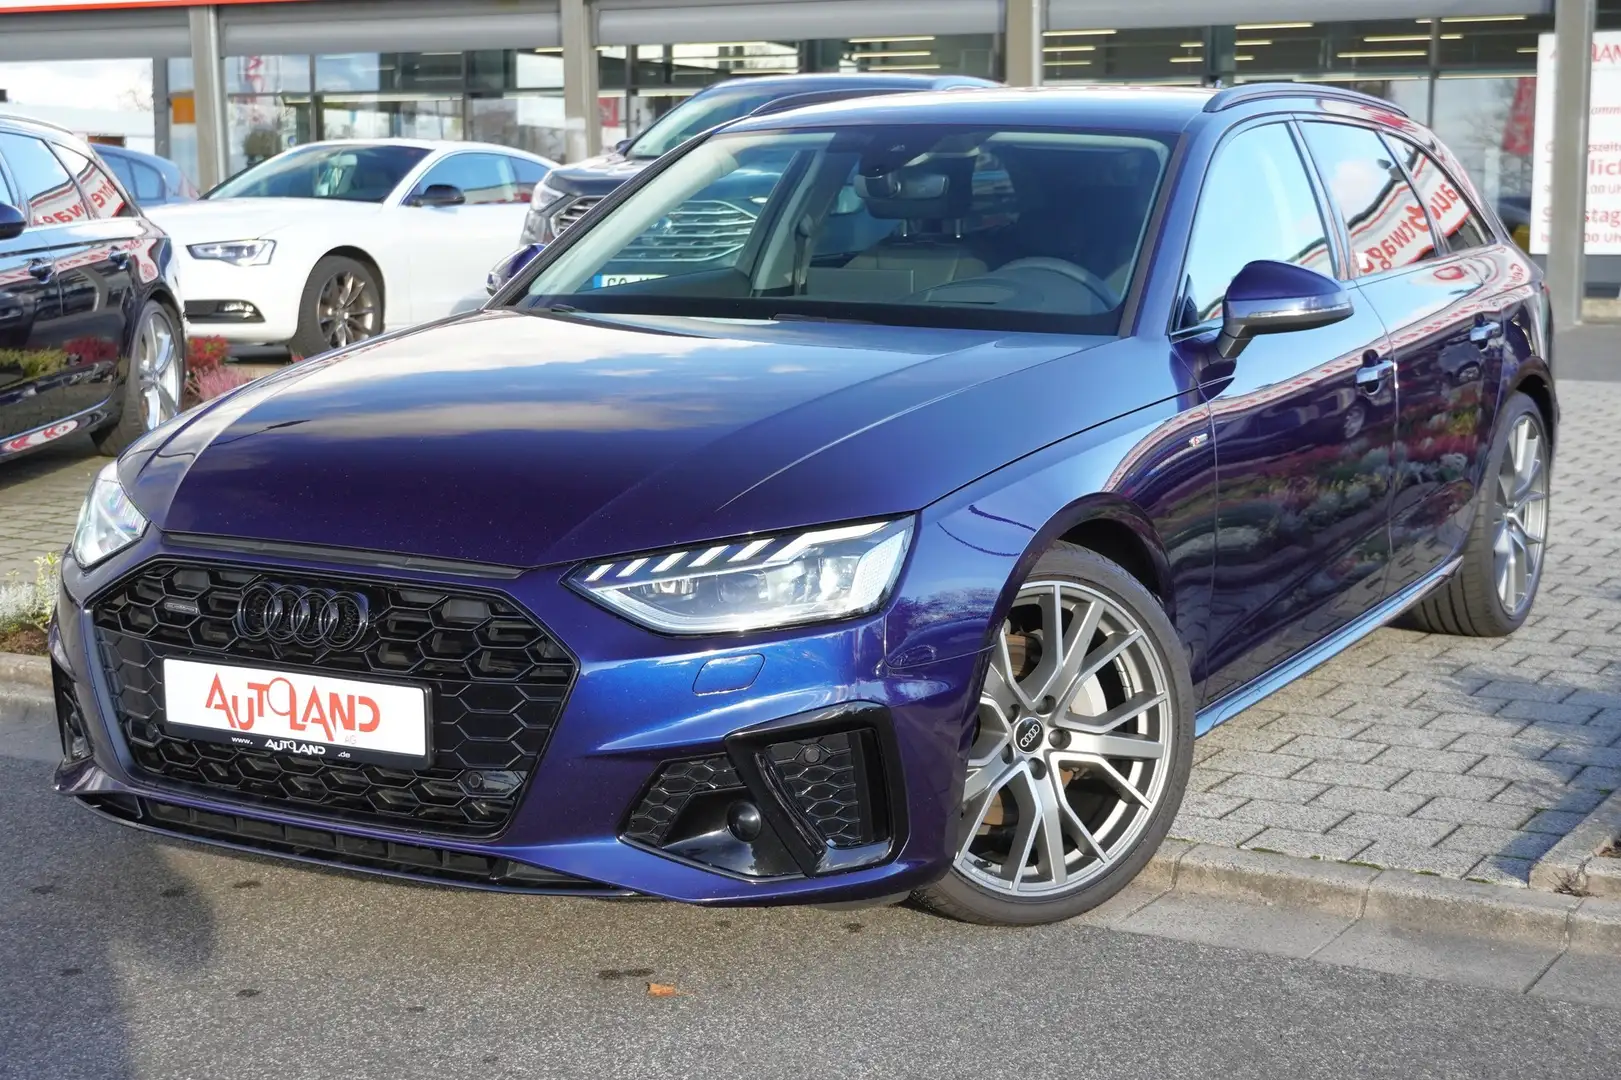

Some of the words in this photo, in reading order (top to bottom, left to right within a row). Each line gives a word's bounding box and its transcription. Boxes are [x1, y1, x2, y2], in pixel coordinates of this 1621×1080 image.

[205, 672, 381, 741] AUTOLAND
[231, 736, 253, 745] www.
[265, 738, 326, 755] AUTOLAND
